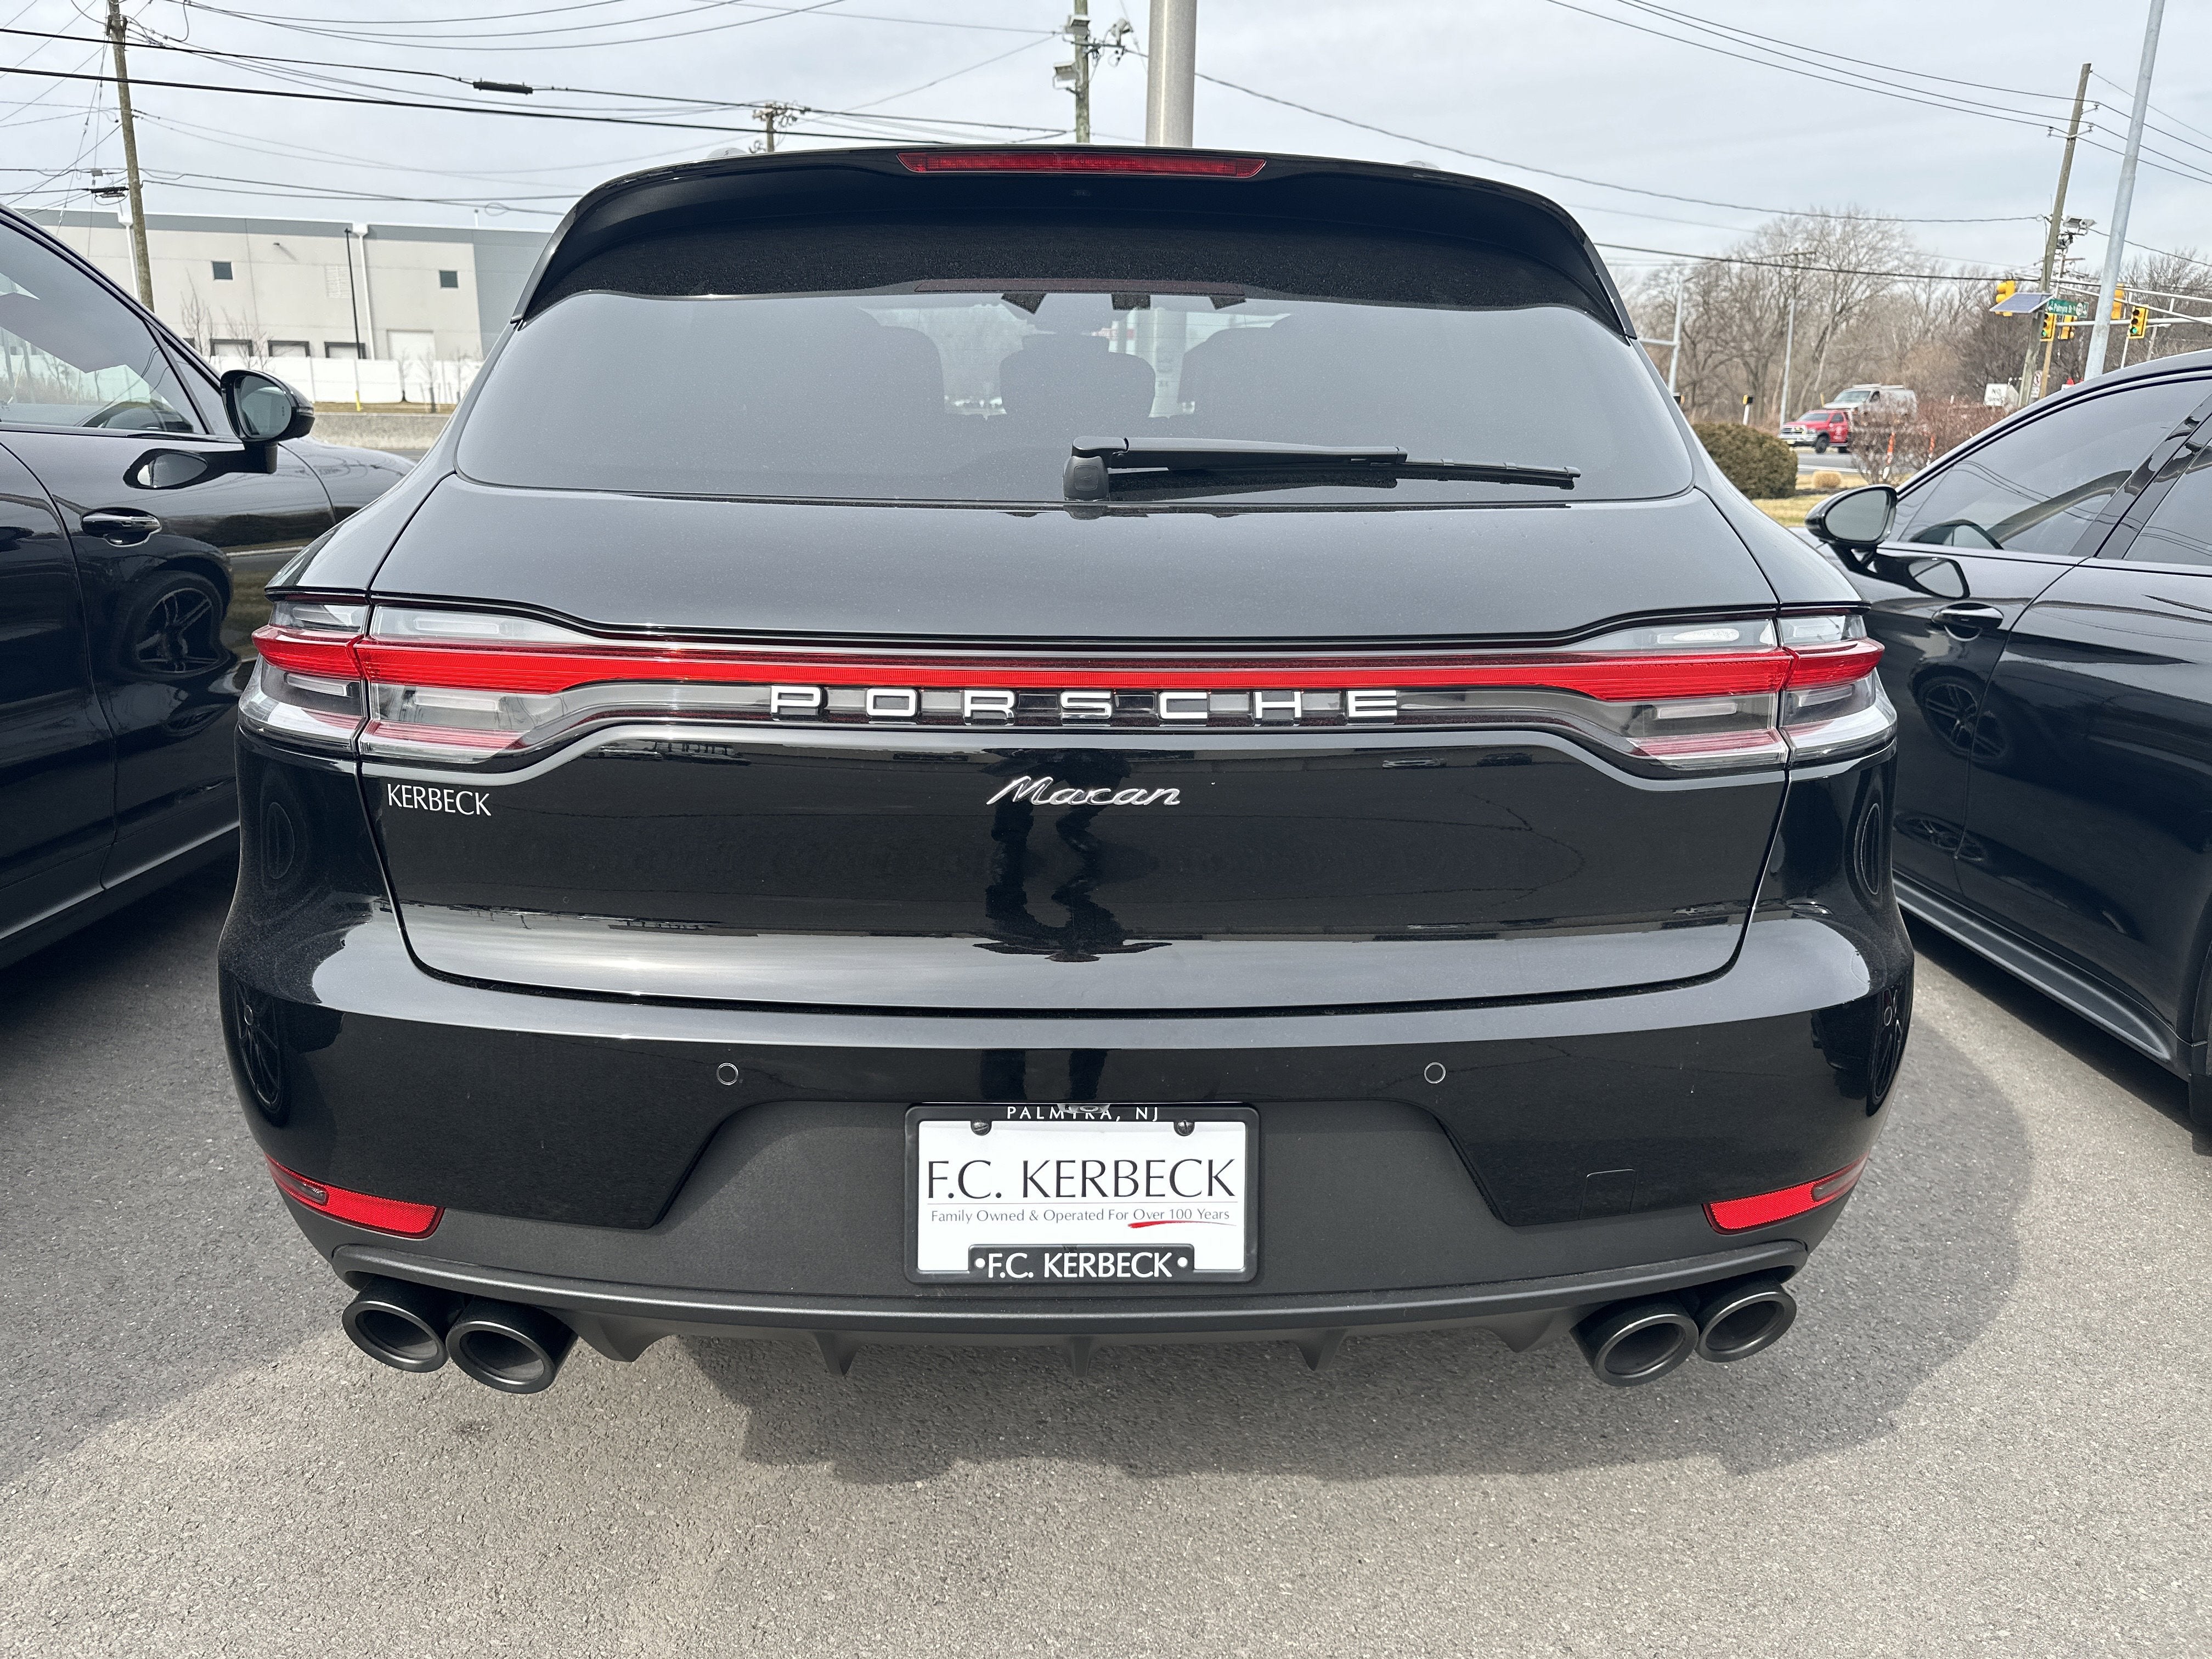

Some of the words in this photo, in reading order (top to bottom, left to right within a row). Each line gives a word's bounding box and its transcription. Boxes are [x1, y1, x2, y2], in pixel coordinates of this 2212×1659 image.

[770, 685, 1398, 720] PORSCHE
[387, 783, 492, 816] KERBECK
[986, 775, 1181, 806] Macan
[1136, 1107, 1158, 1122] NJ
[928, 1159, 1002, 1199] F.C.
[1023, 1159, 1235, 1198] KERBECK
[932, 1209, 973, 1223] Family
[977, 1209, 1024, 1222] Owned
[1029, 1210, 1039, 1221] &
[1043, 1208, 1104, 1223] Operated
[1108, 1209, 1129, 1220] For
[1133, 1209, 1165, 1221] Over
[1169, 1208, 1192, 1220] 100
[1197, 1208, 1230, 1220] Years
[988, 1252, 1034, 1278] F.C.
[1044, 1251, 1172, 1278] KERBECK
